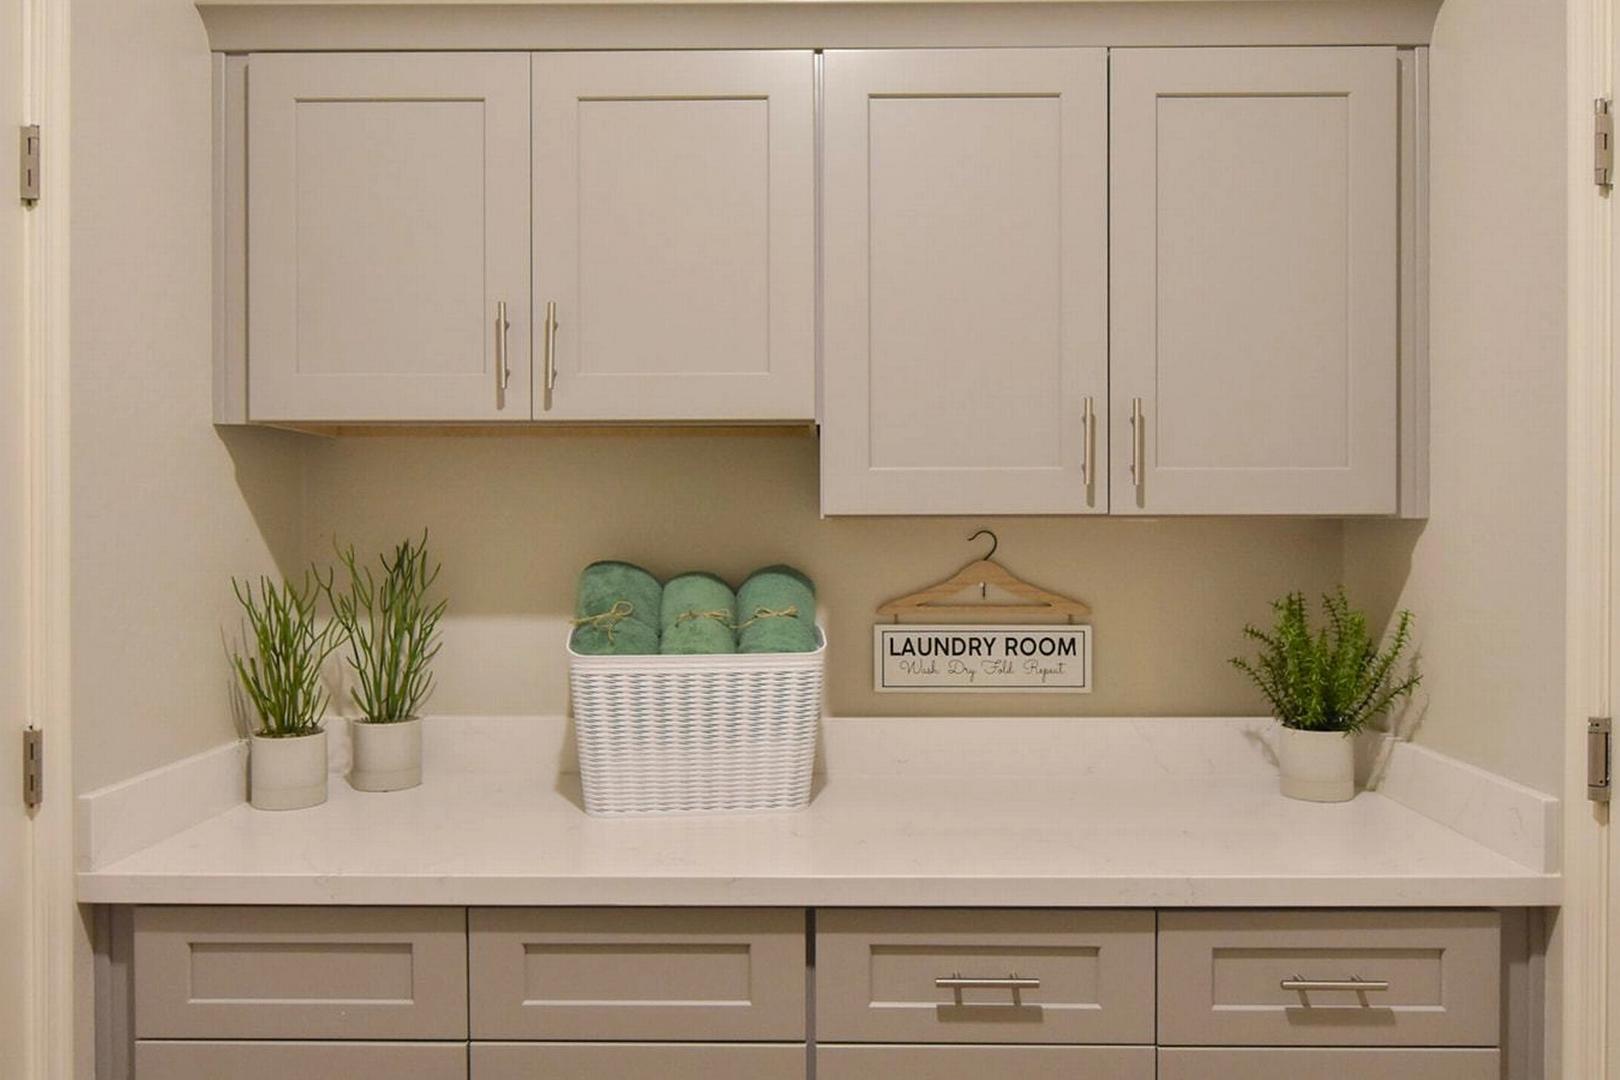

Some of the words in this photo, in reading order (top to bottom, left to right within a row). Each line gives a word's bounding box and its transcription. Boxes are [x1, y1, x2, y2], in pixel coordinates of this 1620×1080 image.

[889, 637, 996, 656] LAUNDRY
[1005, 637, 1077, 656] ROOM
[900, 659, 939, 675] Wash
[947, 659, 977, 683] Dry
[980, 659, 1014, 675] Fold
[1023, 658, 1067, 683] Repeat
